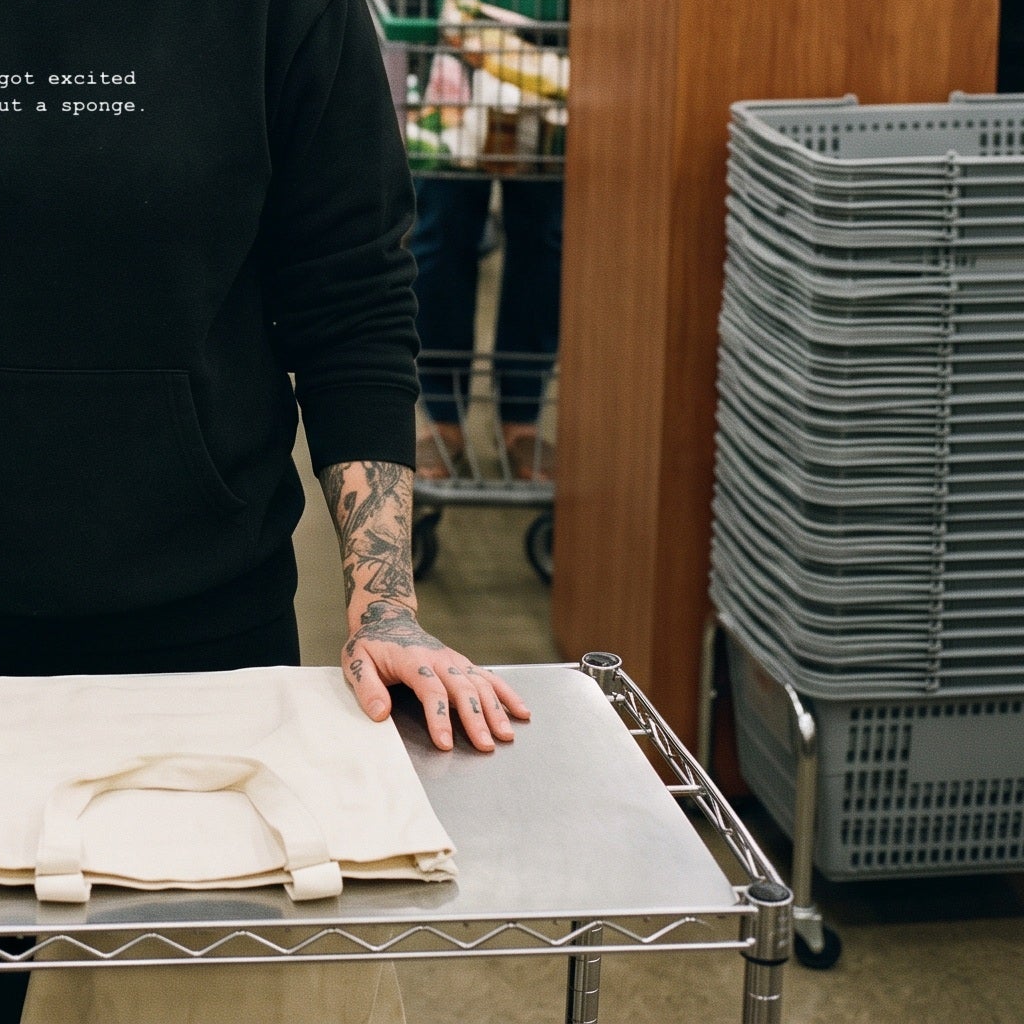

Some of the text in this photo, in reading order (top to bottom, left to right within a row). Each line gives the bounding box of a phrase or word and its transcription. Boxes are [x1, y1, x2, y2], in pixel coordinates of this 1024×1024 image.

[48, 70, 137, 85] excited
[35, 100, 48, 112] a
[61, 100, 145, 116] sponge.
